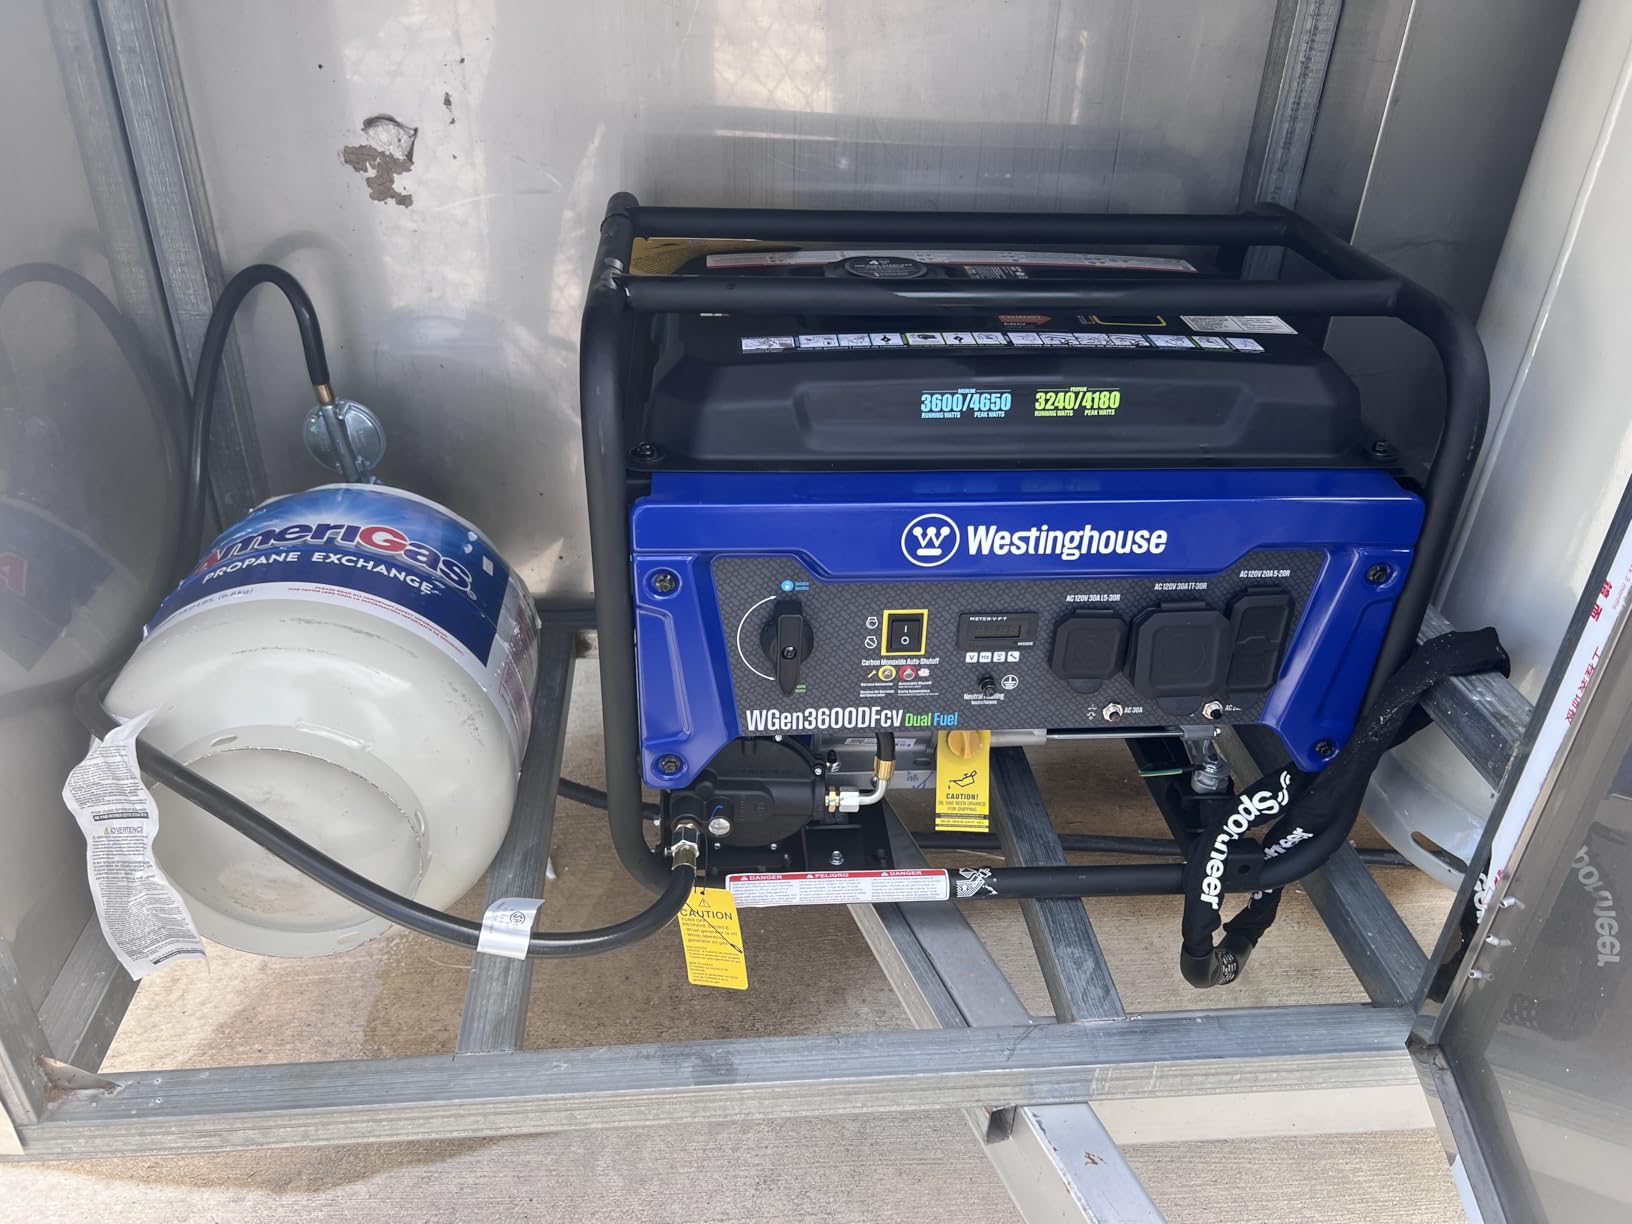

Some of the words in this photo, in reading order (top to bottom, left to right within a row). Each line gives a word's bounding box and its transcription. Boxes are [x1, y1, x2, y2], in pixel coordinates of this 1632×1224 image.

[920, 393, 1012, 412] 3600/4650
[1034, 391, 1121, 410] 3240/4180
[967, 524, 1168, 561] Westinghouse
[194, 522, 473, 592] AmeriGas
[202, 551, 301, 584] PROPANE
[311, 551, 434, 594] EXCHANGE
[1273, 569, 1291, 577] 5-20R
[1075, 594, 1089, 602] 120V
[1088, 594, 1100, 602] 30A
[1100, 594, 1121, 602] L5-30R
[881, 658, 906, 666] Monoxide
[904, 712, 932, 727] Dual
[932, 711, 958, 726] Fuel
[680, 908, 733, 920] CAUTION
